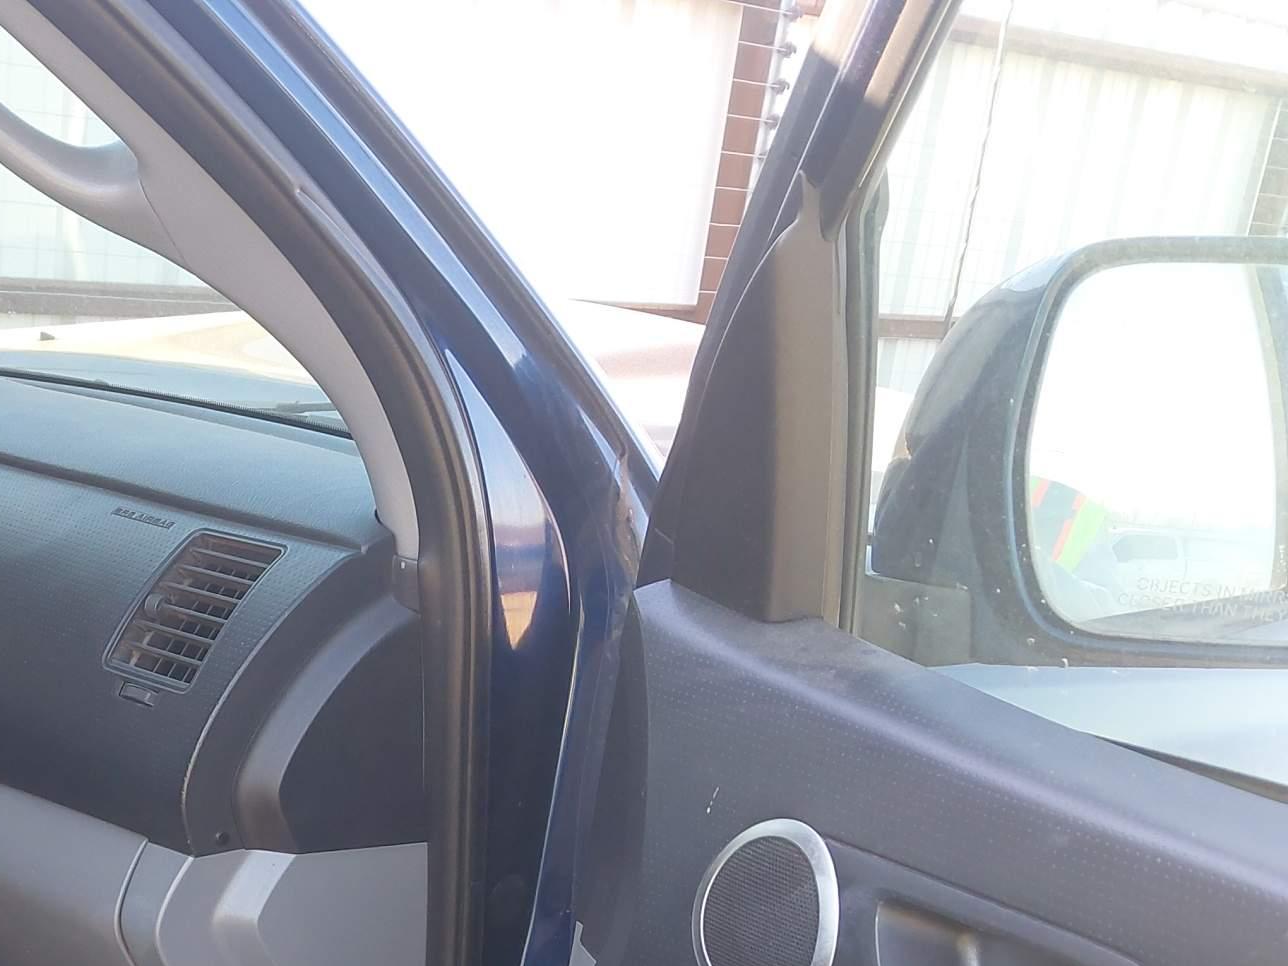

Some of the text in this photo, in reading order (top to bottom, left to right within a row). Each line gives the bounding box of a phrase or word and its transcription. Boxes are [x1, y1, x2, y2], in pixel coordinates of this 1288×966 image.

[138, 513, 176, 528] AIRBAG
[1136, 577, 1214, 597] OBJECTS
[1216, 584, 1236, 600] IN
[1118, 592, 1183, 612] CLOSER
[1191, 600, 1237, 617] THAN
